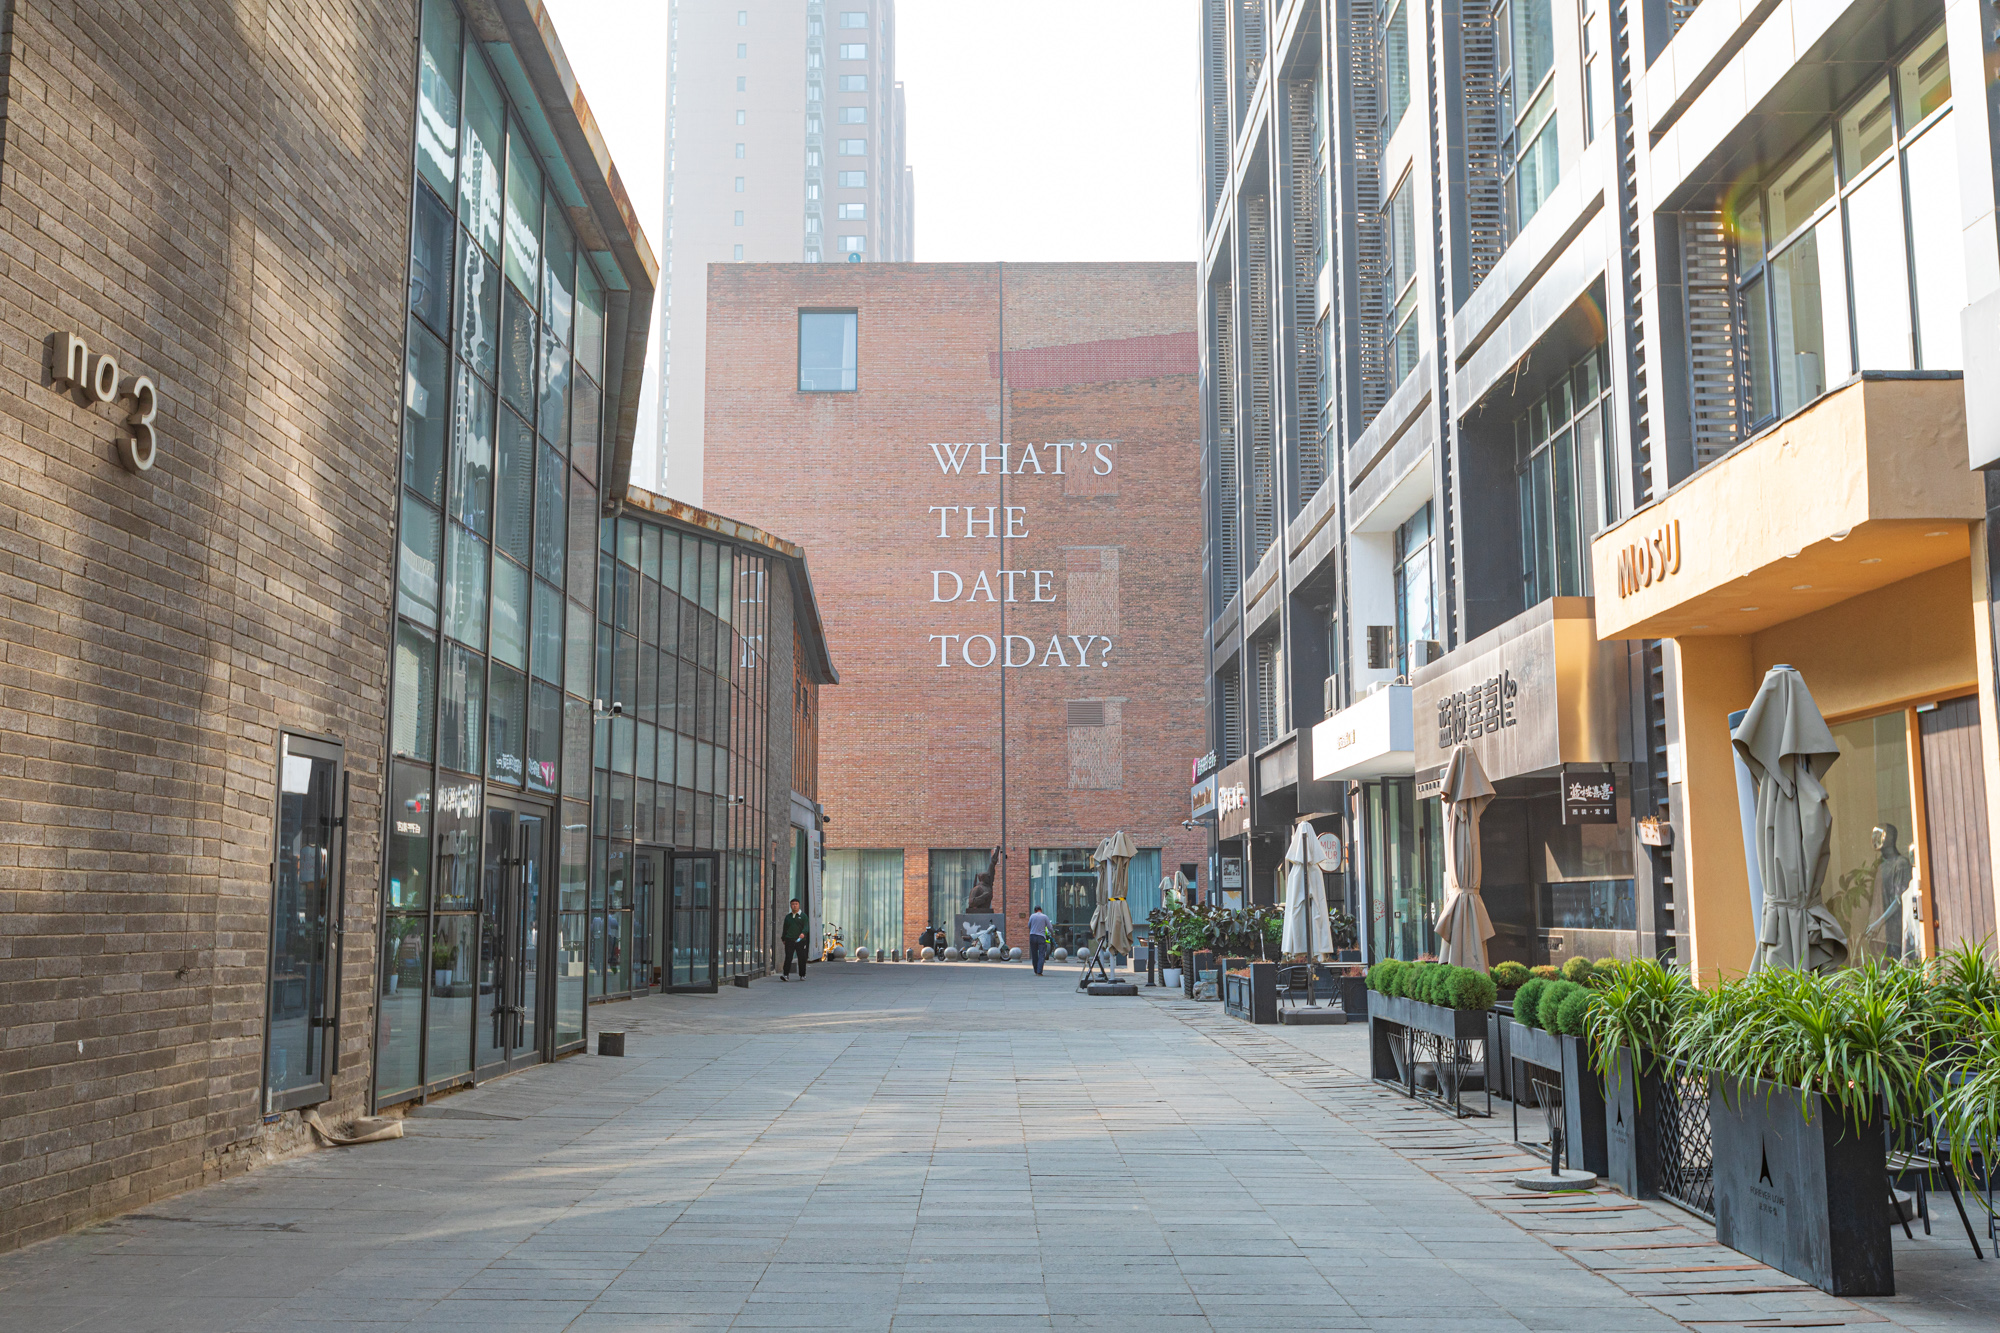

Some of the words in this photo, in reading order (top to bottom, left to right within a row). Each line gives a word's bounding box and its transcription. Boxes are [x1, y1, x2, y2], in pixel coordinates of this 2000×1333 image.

[54, 332, 119, 402] no
[124, 376, 157, 471] 3
[928, 442, 1114, 476] WHAT'S
[928, 505, 1029, 538] THE
[1617, 519, 1681, 599] MOSU
[930, 569, 1057, 602] DATE
[928, 634, 1113, 668] TODAY?
[1320, 840, 1337, 850] MUR
